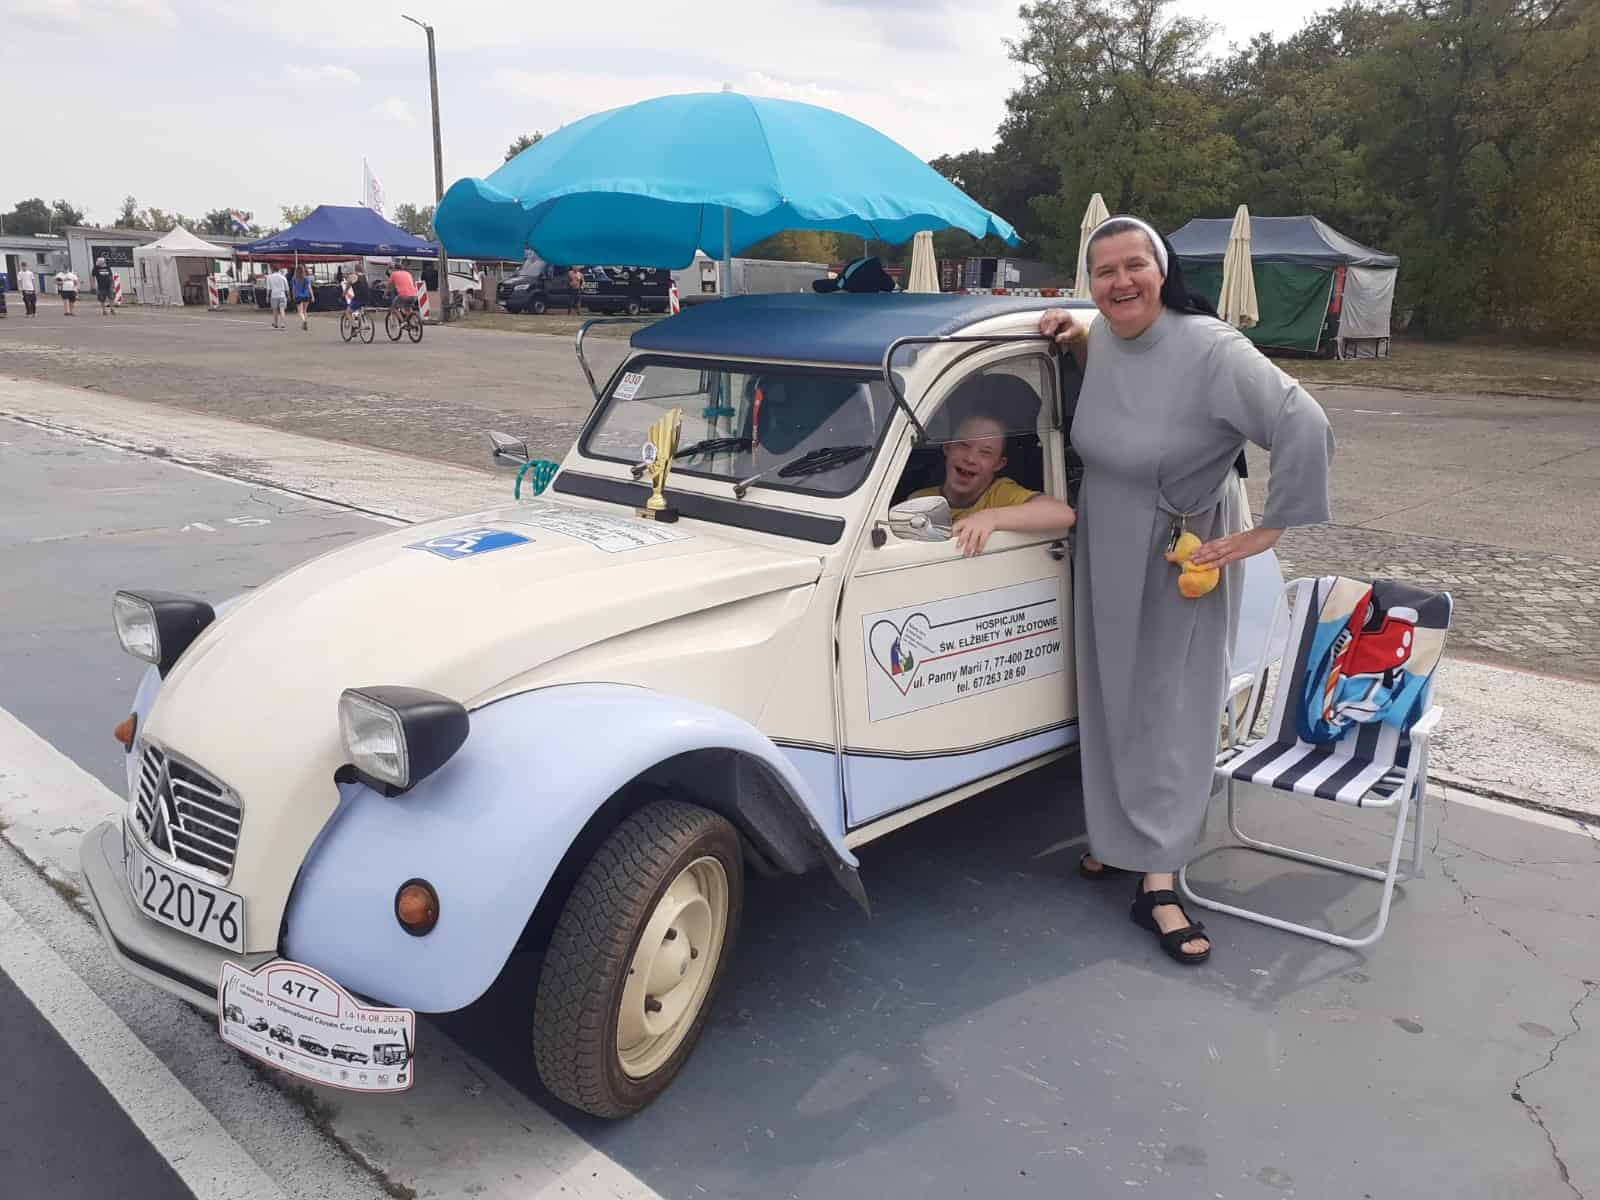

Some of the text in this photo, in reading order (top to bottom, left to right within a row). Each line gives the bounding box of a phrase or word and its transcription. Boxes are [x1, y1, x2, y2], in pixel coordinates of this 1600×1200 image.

[958, 630, 1001, 648] ELŻBIETY
[1004, 627, 1013, 637] W
[1016, 616, 1058, 634] ZŁOTOWIE
[976, 612, 1025, 631] HOSPICJUM
[913, 676, 926, 689] ul.
[927, 670, 958, 684] Panny
[959, 661, 983, 677] Marii
[994, 652, 1023, 668] 77-400
[1024, 640, 1061, 661] ZŁOTÓW
[956, 682, 971, 694] tel.
[1015, 665, 1027, 678] 60
[281, 979, 320, 1003] 477
[378, 1028, 398, 1037] Rally
